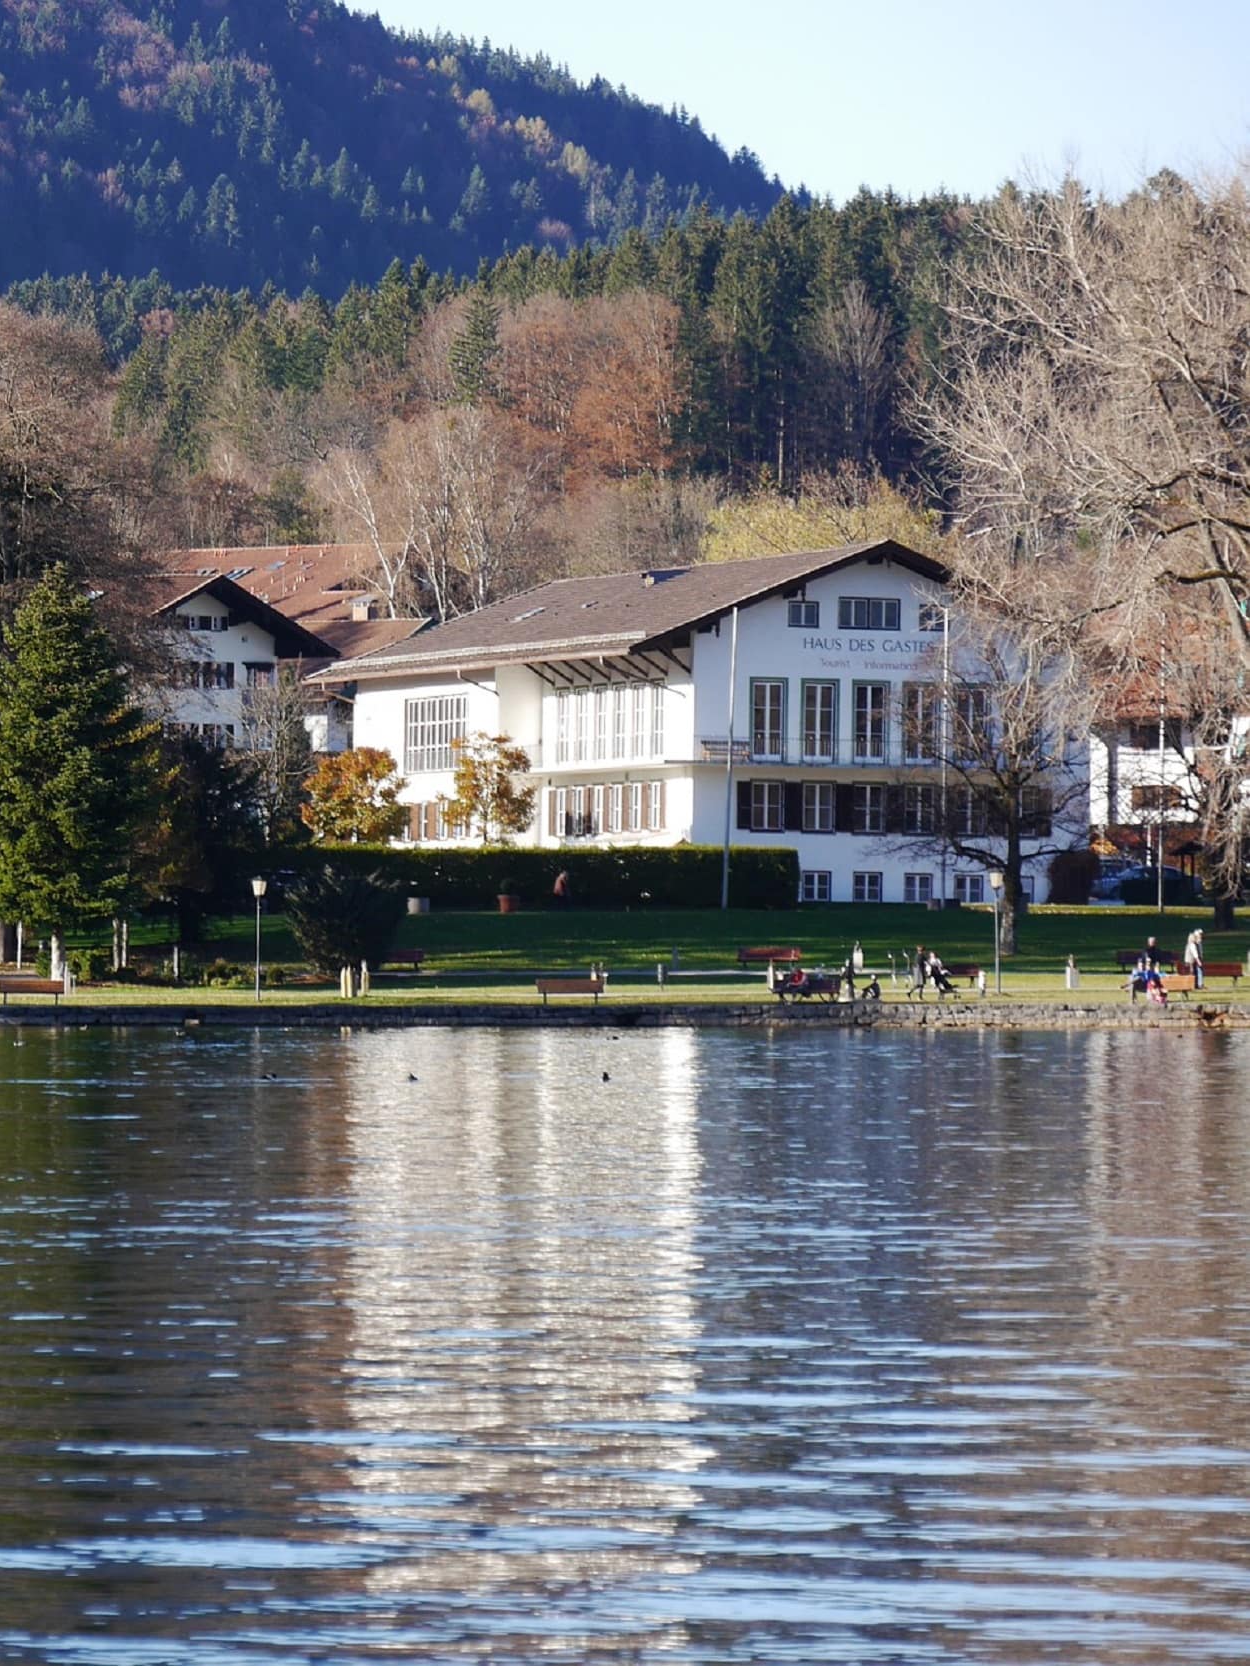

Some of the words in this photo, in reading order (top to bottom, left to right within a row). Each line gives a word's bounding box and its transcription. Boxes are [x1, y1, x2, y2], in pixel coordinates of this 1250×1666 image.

[803, 637, 842, 650] HAUS
[849, 638, 875, 651] DES
[882, 639, 936, 653] GASTES
[820, 657, 851, 669] Tourist
[864, 659, 919, 671] Information
